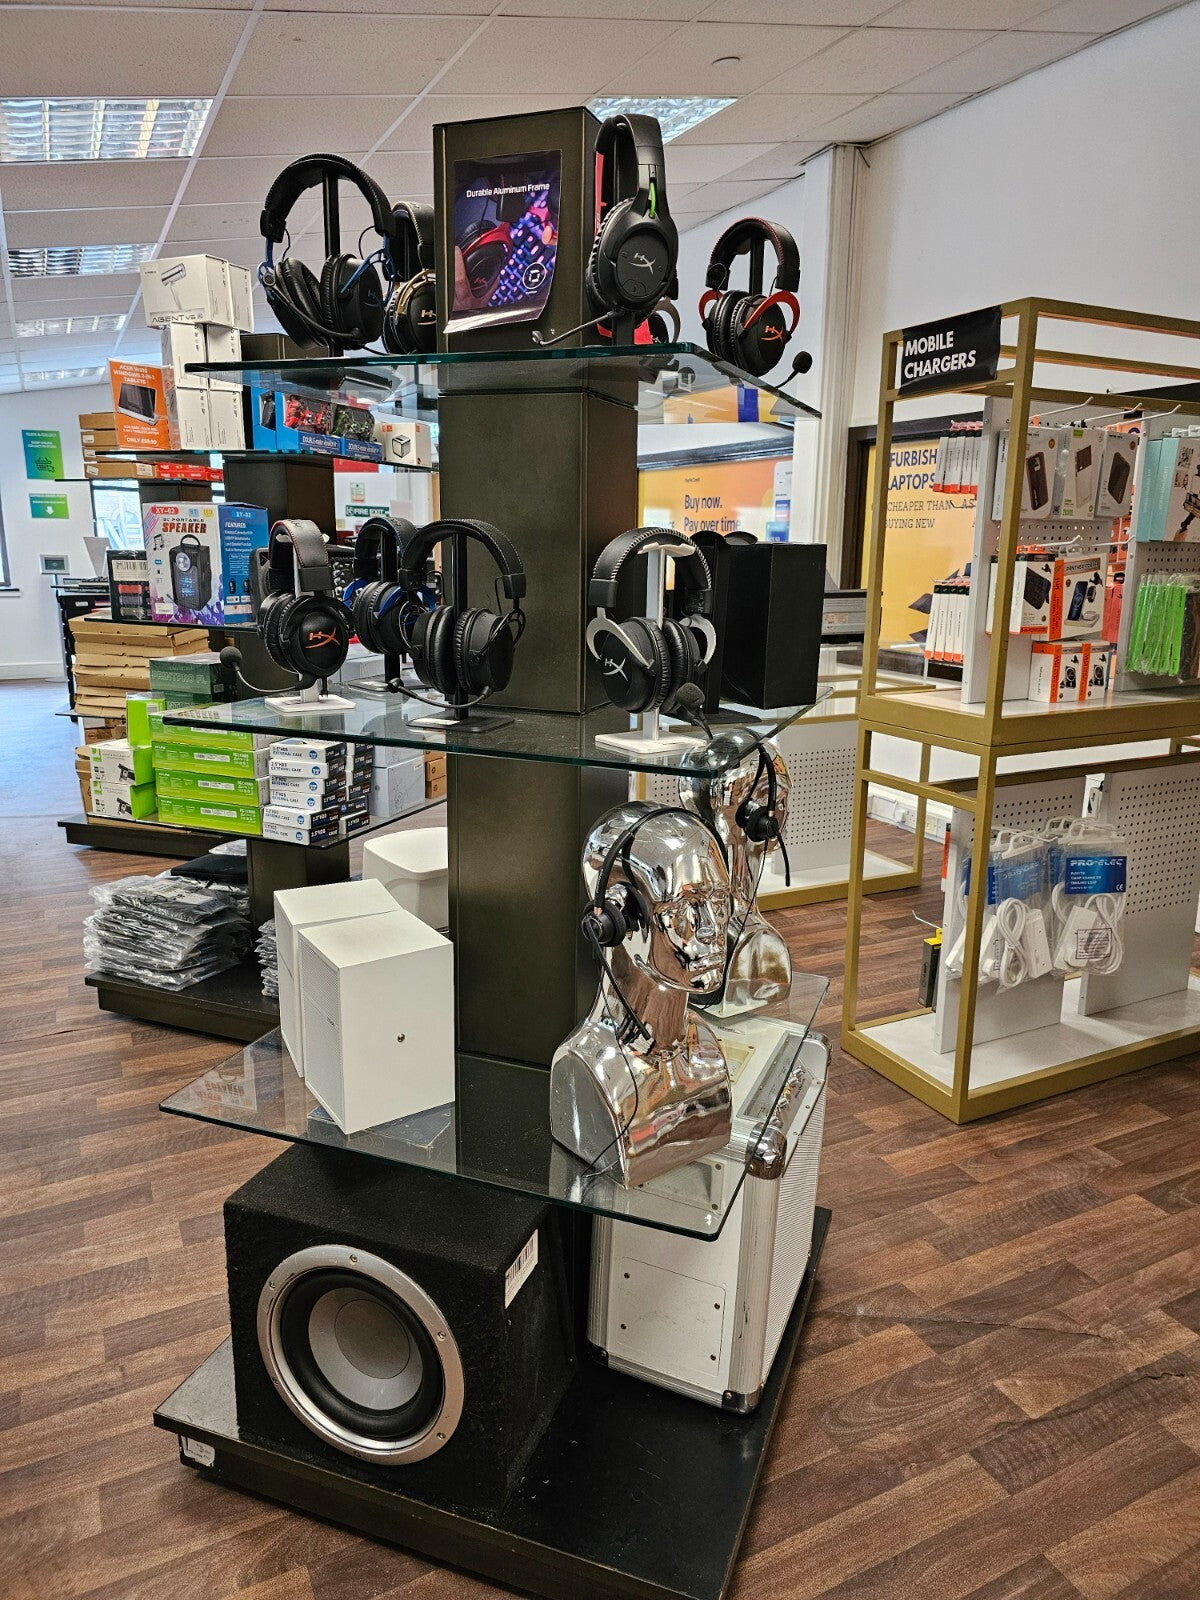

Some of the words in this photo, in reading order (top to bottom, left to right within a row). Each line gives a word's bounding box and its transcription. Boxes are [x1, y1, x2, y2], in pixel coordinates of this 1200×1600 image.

[466, 188, 493, 198] Durable
[493, 185, 527, 195] Aluminum
[527, 183, 550, 192] Frame
[904, 330, 954, 357] MOBILE
[904, 350, 977, 379] CHARGERS
[889, 448, 938, 467] FURBISH
[888, 473, 936, 490] APTOPS
[684, 494, 699, 513] Buy
[701, 496, 723, 509] now.
[887, 500, 924, 512] CHEAPER
[926, 499, 952, 511] THAN
[162, 522, 207, 534] SPEAKER
[684, 516, 699, 532] Pay
[700, 519, 720, 531] over
[915, 518, 935, 528] NEW
